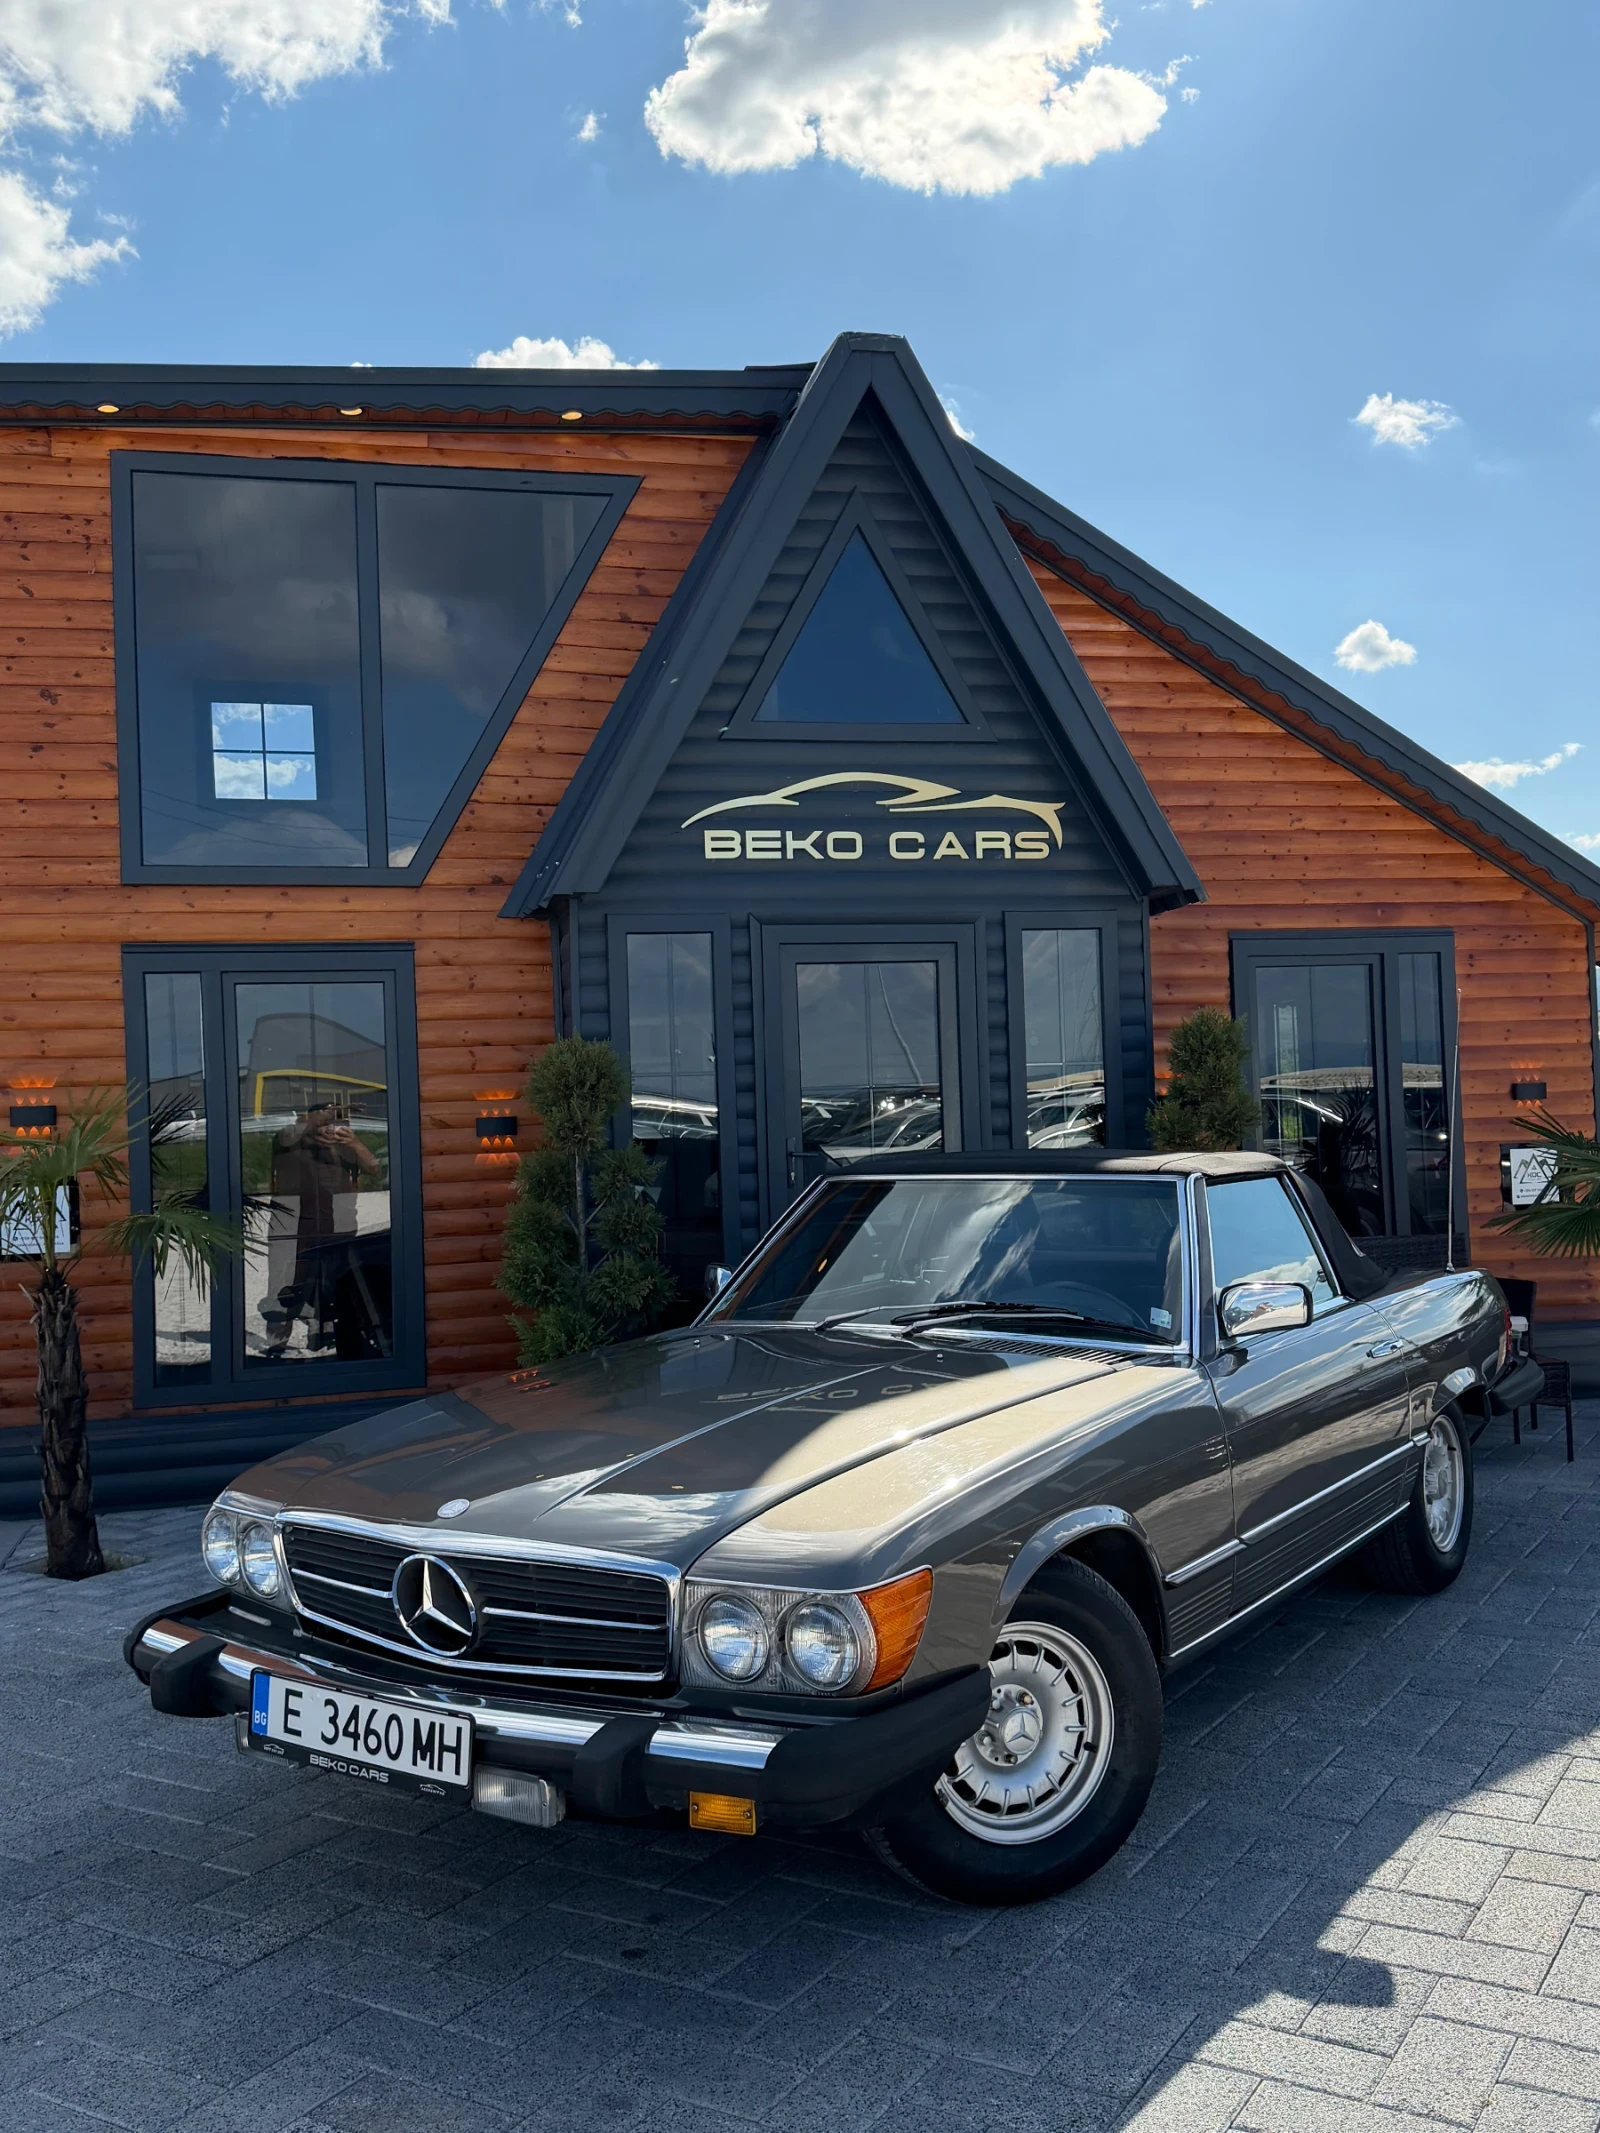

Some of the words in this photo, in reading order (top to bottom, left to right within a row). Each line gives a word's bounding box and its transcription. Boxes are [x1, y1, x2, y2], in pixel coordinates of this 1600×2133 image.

[704, 830, 863, 860] BEKO
[888, 831, 1050, 860] CARS
[254, 1710, 267, 1726] BG
[284, 1688, 303, 1737] E
[321, 1698, 404, 1761] 3460
[412, 1718, 463, 1776] MH
[309, 1753, 348, 1773] BEKO
[349, 1764, 390, 1784] CARS
